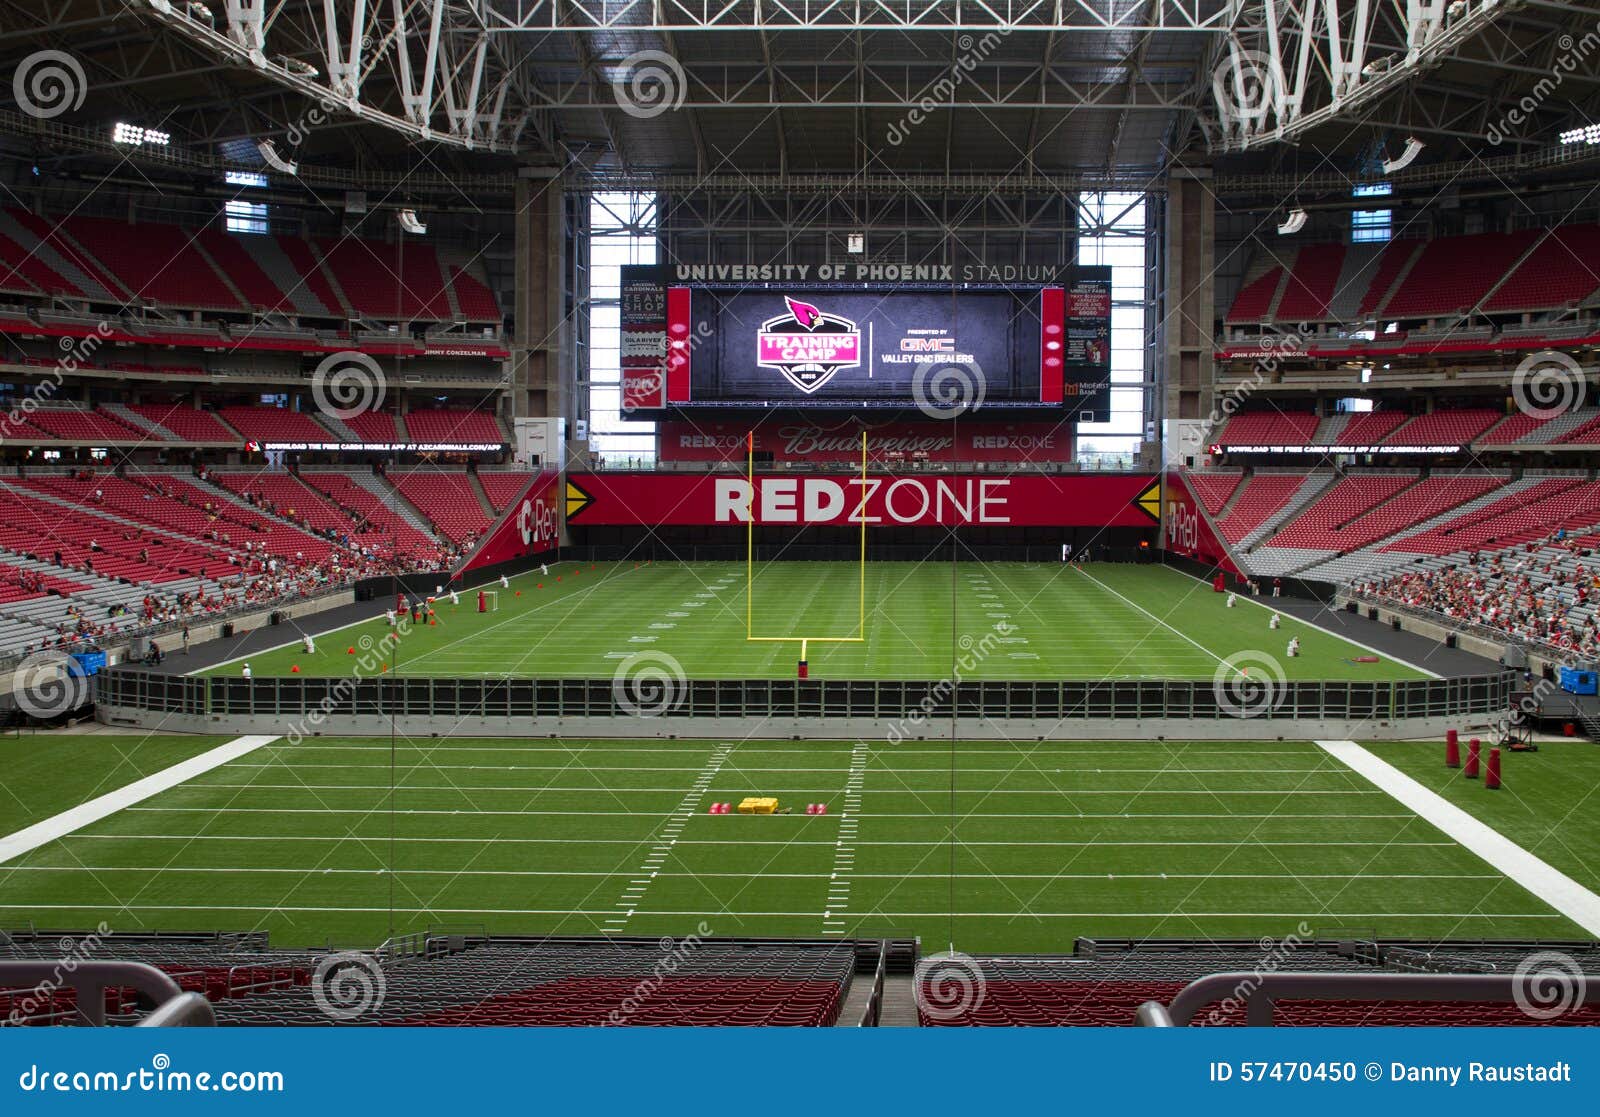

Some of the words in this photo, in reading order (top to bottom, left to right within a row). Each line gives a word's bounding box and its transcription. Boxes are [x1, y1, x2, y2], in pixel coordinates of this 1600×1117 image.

[677, 264, 811, 280] UNIVERSITY
[818, 264, 847, 280] OF
[857, 265, 953, 281] PHOENIX
[963, 265, 1057, 281] STADIUM
[623, 293, 665, 303] TEAM
[623, 303, 665, 311] SHOP
[763, 336, 854, 349] TRAINING
[900, 338, 955, 352] GMC
[781, 348, 837, 361] CAMP
[882, 354, 913, 364] VALLEY
[934, 354, 974, 364] DEALERS
[777, 427, 953, 455] Budweiser
[972, 436, 1055, 449] REDZONE
[714, 479, 1011, 524] REDZONE
